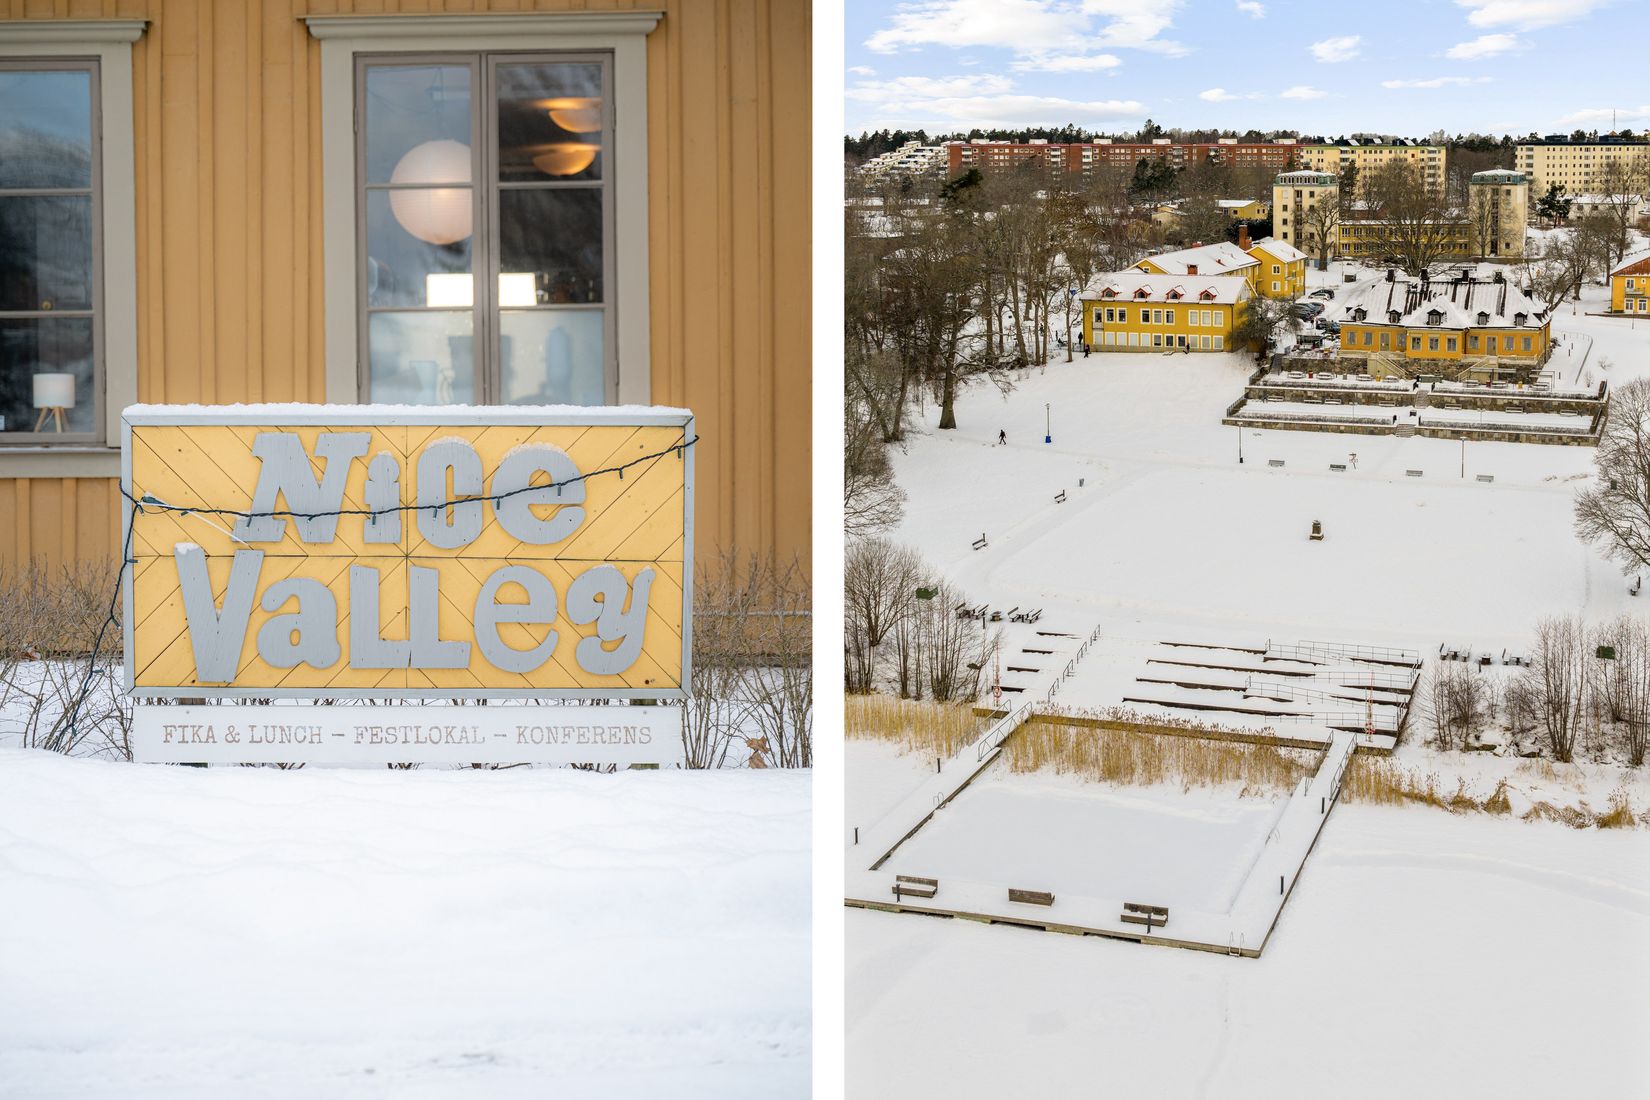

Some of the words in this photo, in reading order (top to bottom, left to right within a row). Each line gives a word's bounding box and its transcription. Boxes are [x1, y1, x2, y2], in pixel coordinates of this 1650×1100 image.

[162, 725, 217, 744] FIKA
[224, 725, 241, 744] &
[248, 725, 323, 744] LUNCH
[353, 726, 486, 744] FESTLOKAL
[516, 726, 652, 745] KONFERENS
